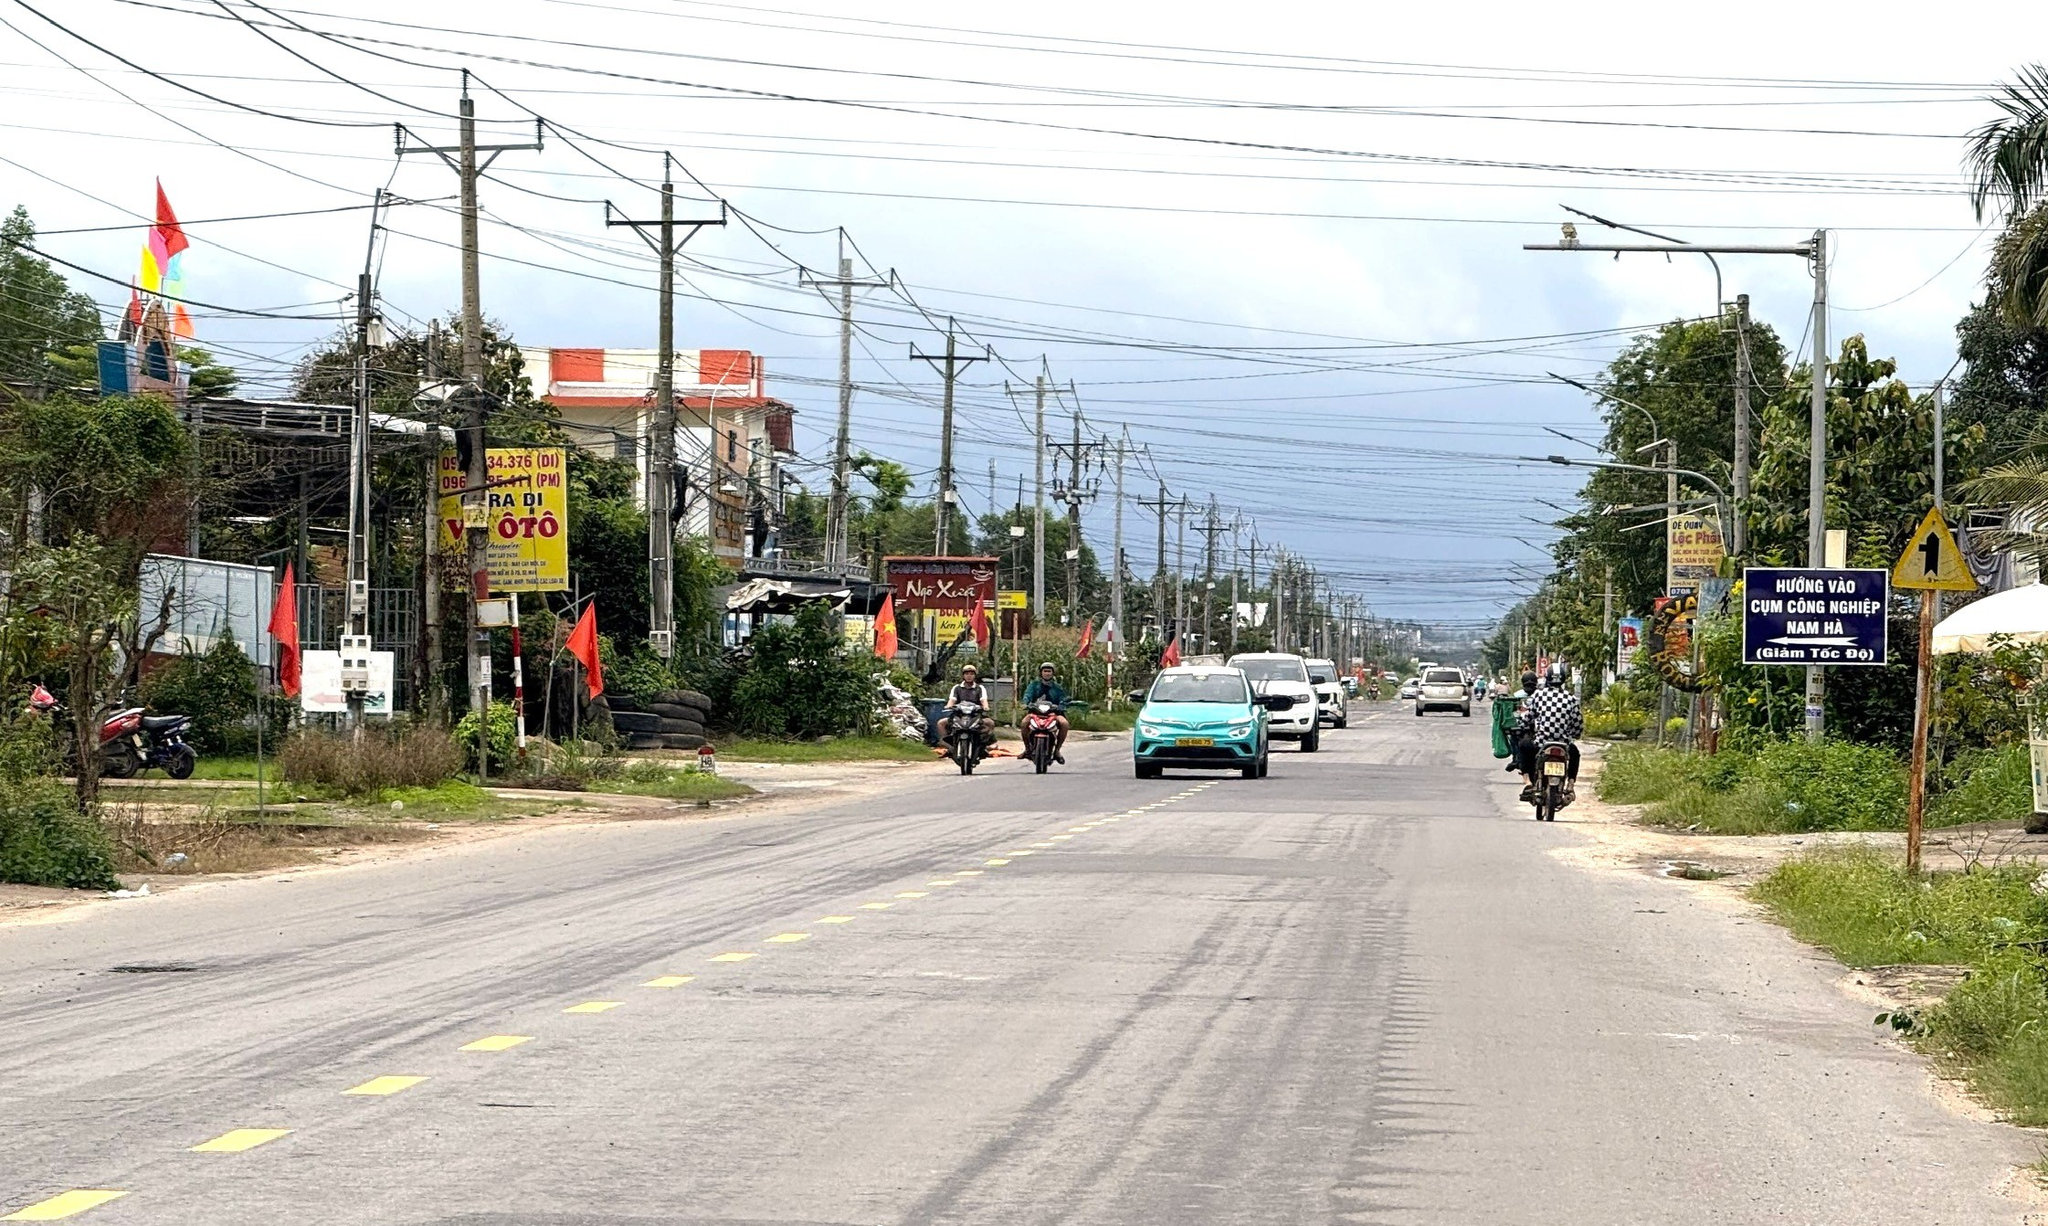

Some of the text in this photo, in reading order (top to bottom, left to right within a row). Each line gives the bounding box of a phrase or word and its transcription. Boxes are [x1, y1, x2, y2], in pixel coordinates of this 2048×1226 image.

[442, 452, 560, 470] 0934.376 (DI)
[537, 472, 560, 488] (PM)
[498, 510, 559, 539] ÔTÔ
[1776, 576, 1856, 594] HƯỚNG VÀO
[1751, 597, 1881, 617] CỤM CÔNG NGHIỆP
[1786, 618, 1843, 634] NAM HÀ
[1756, 647, 1874, 660] (Giảm Tốc Độ)
